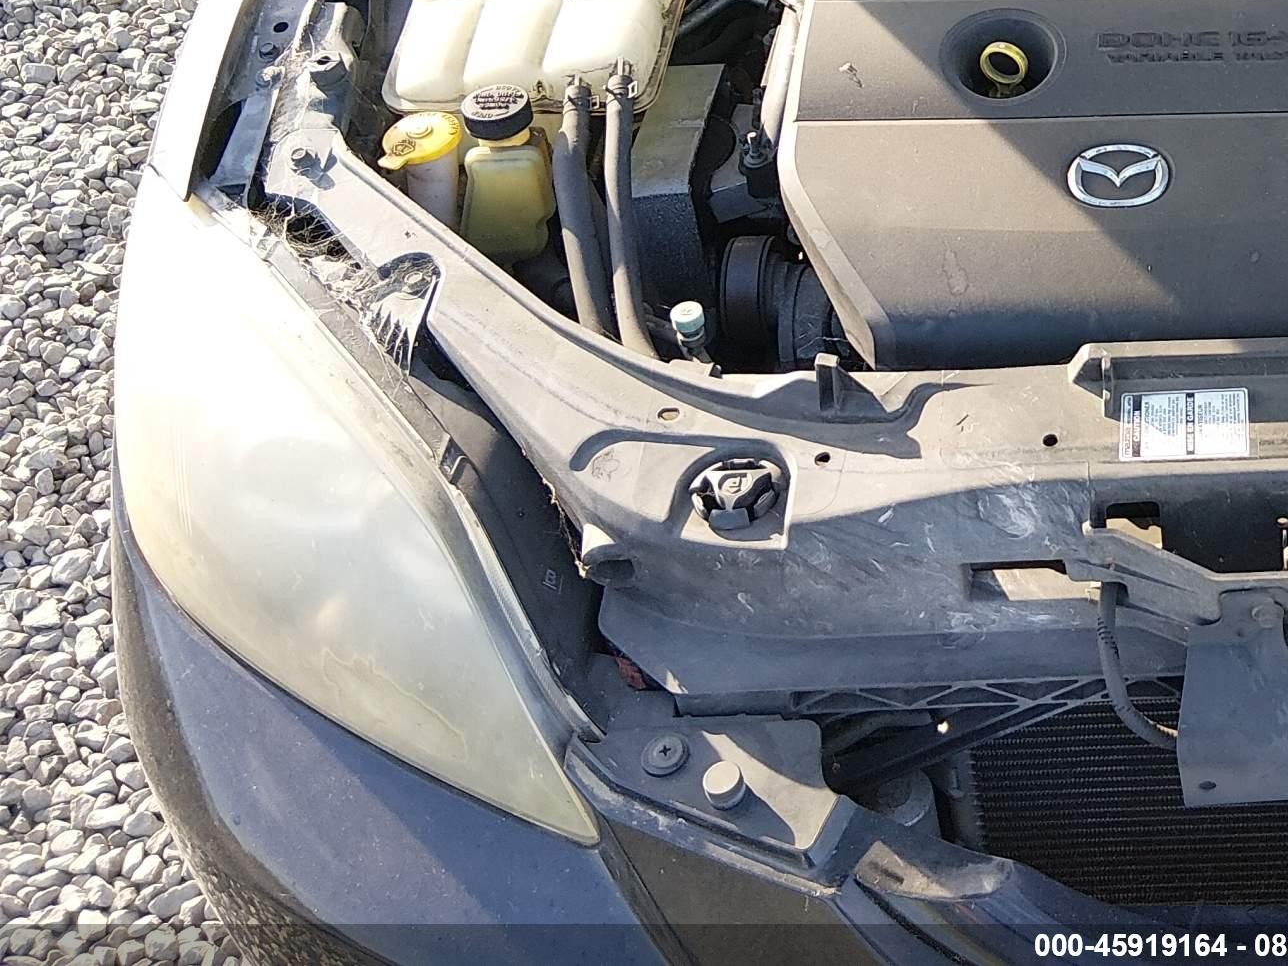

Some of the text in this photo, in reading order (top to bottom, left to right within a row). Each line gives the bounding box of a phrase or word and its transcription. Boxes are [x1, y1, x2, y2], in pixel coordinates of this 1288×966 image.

[1097, 31, 1220, 49] DOHC
[1186, 396, 1194, 422] GARDE
[1133, 410, 1141, 442] CAUTION
